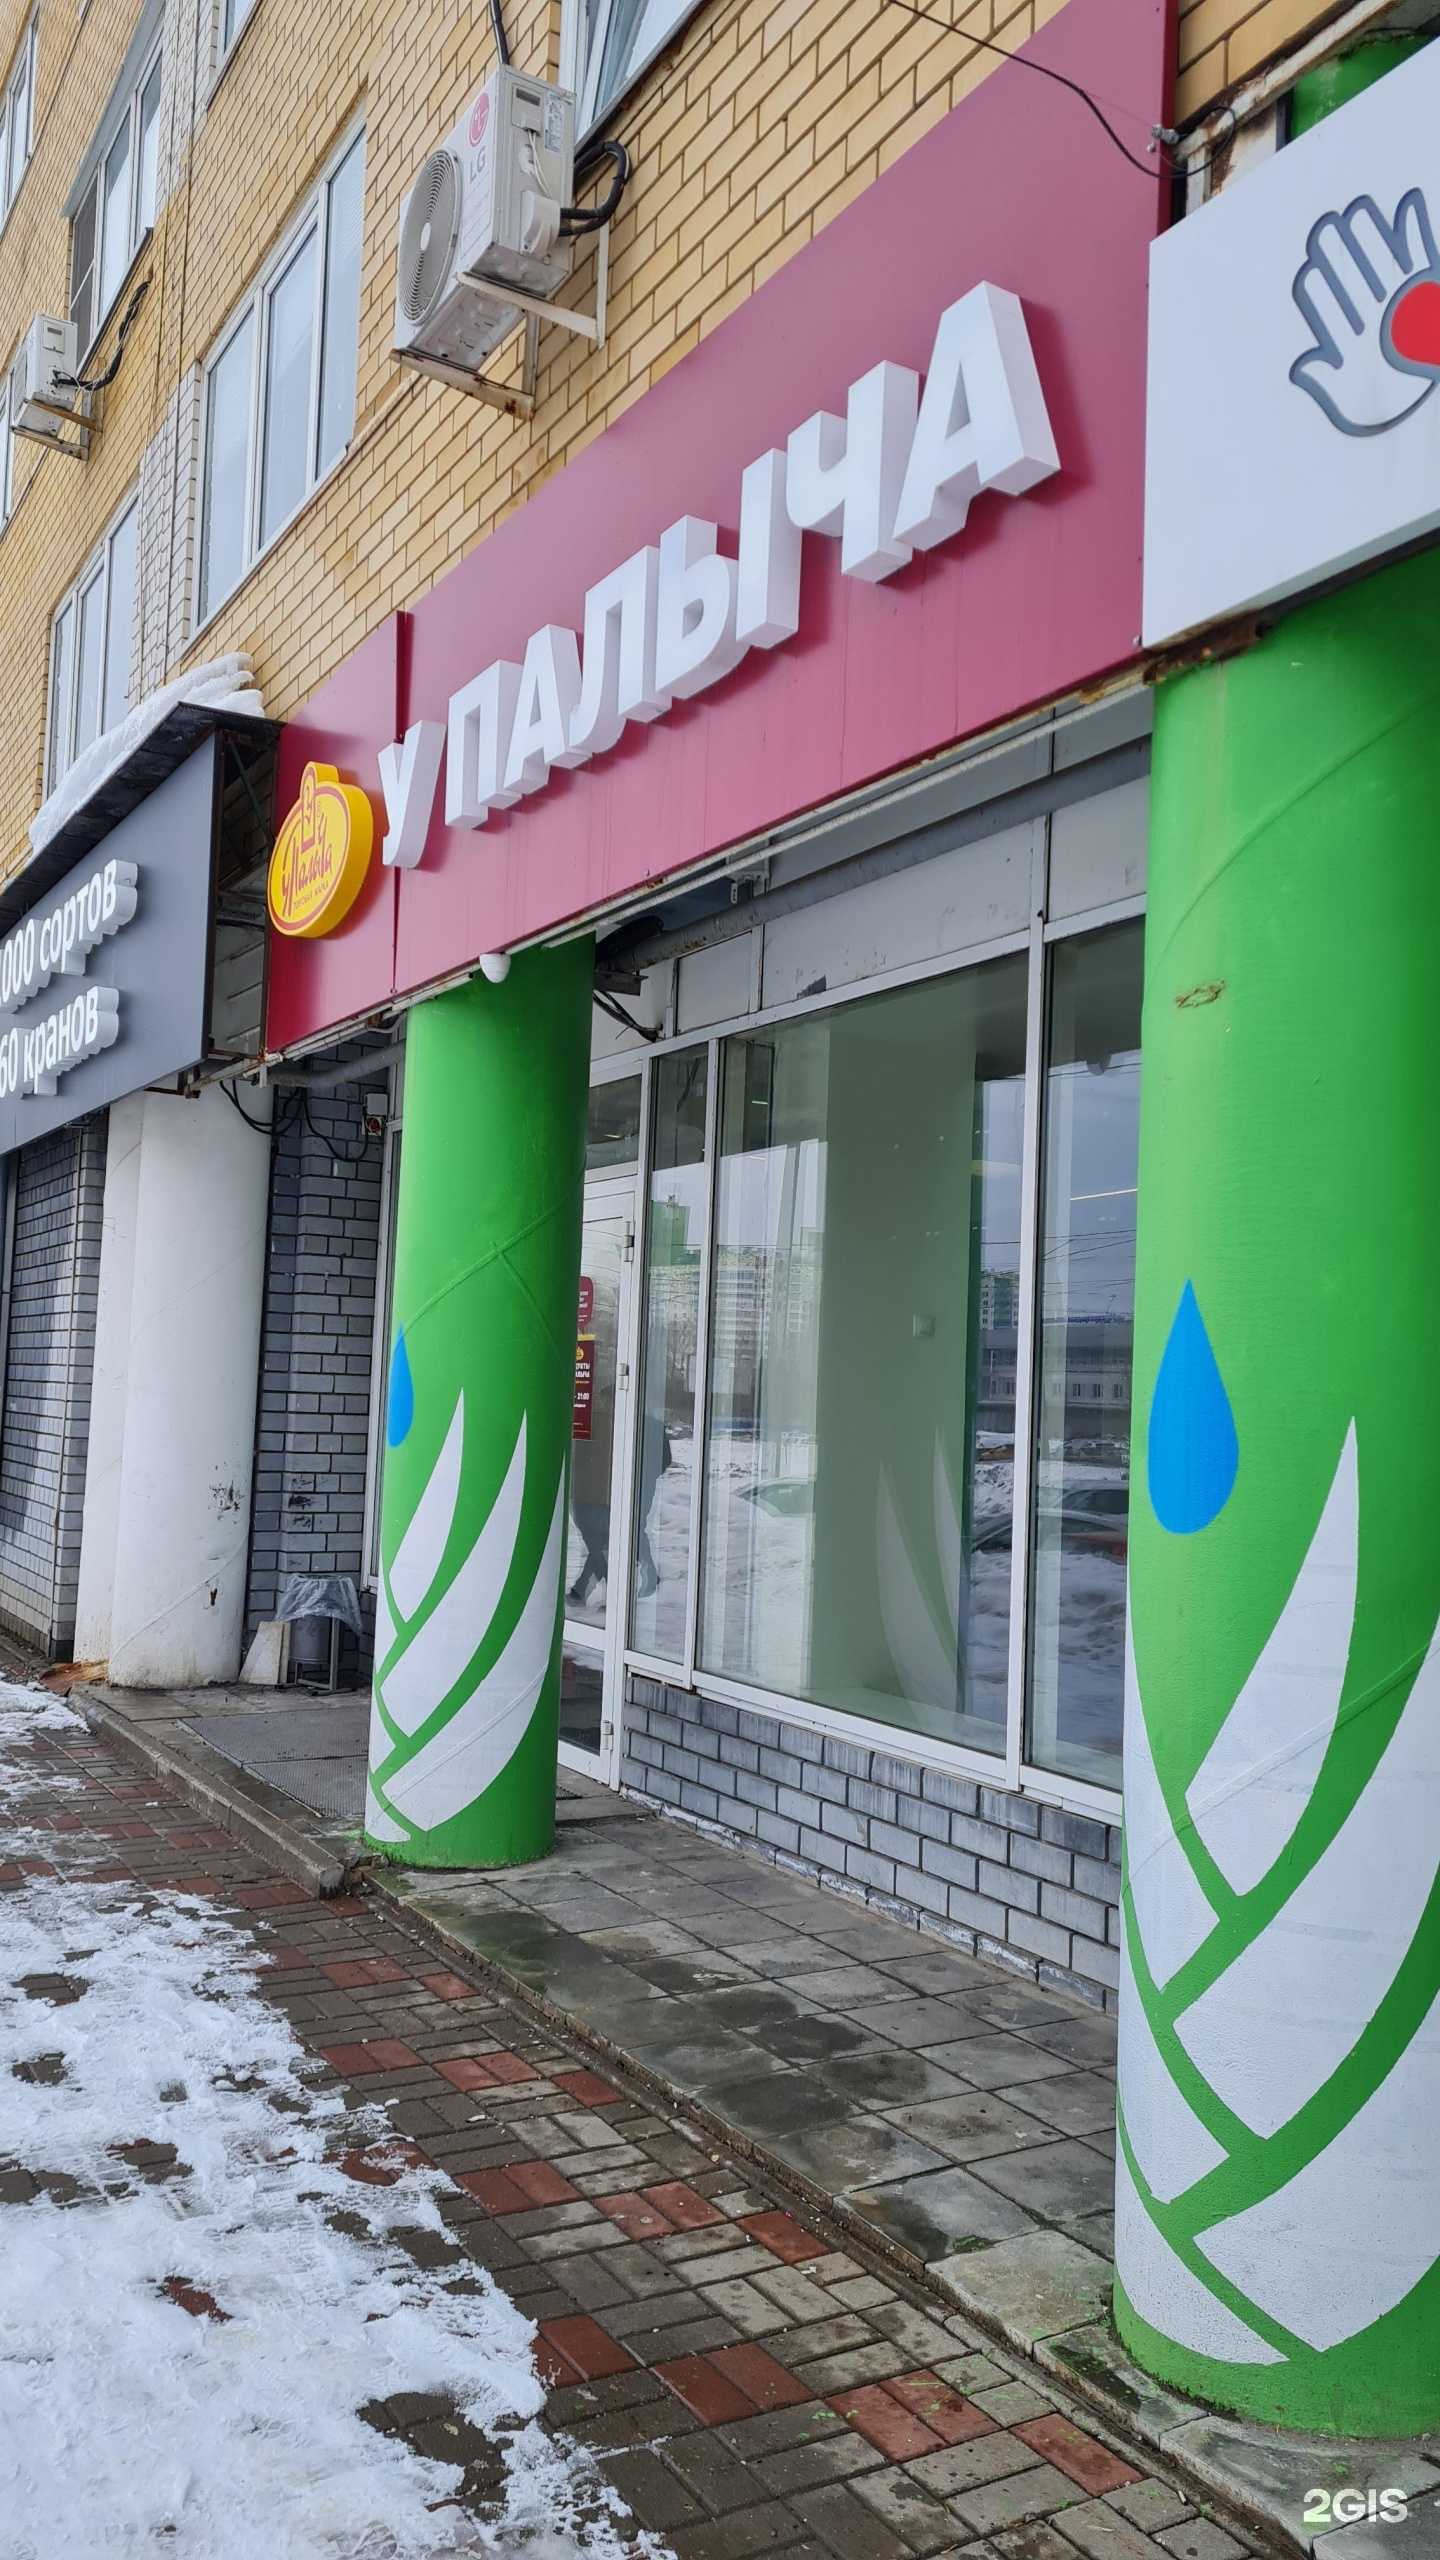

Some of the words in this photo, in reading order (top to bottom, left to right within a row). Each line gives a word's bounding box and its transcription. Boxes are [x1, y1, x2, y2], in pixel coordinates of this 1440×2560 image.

[468, 146, 487, 184] LG
[377, 719, 440, 868] У
[445, 281, 1060, 828] ПАЛЫЧА
[0, 918, 36, 1004] 000
[40, 859, 122, 974] сортов
[24, 985, 105, 1095] кранов
